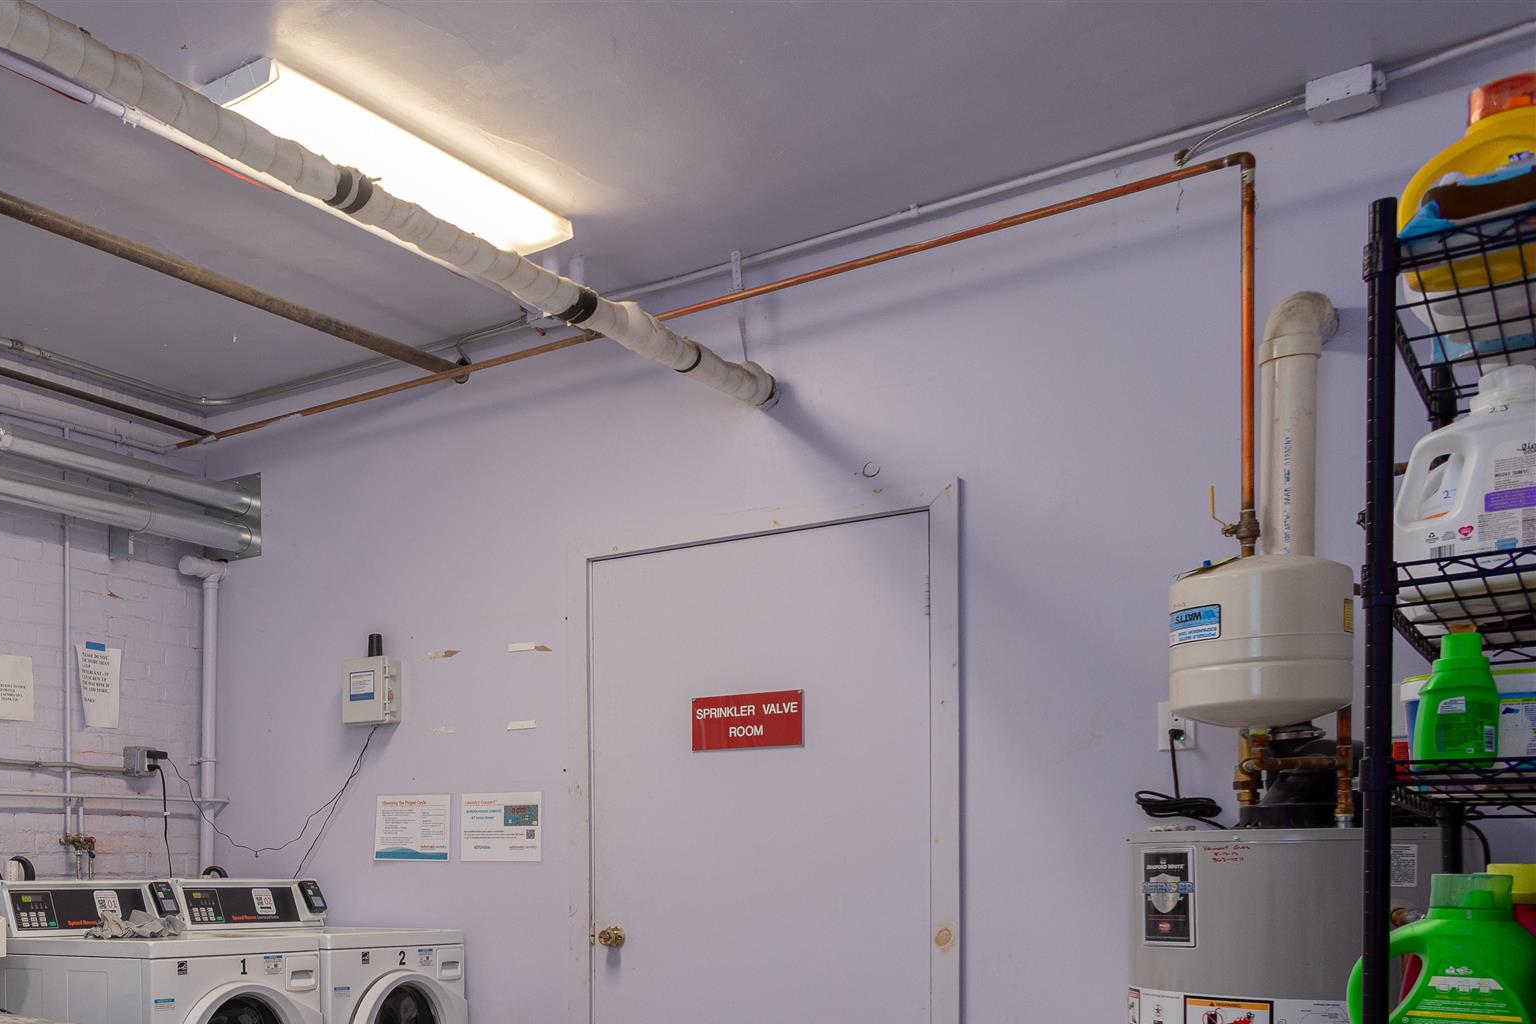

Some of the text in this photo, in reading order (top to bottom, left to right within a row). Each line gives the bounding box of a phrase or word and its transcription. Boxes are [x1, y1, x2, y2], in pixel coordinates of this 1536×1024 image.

[1175, 612, 1202, 624] WATTS
[696, 701, 798, 720] SPRINKLER VALVE
[729, 725, 764, 737] ROOM
[108, 900, 117, 908] 01
[264, 897, 272, 905] 02
[399, 951, 406, 966] 2
[240, 958, 247, 975] 1
